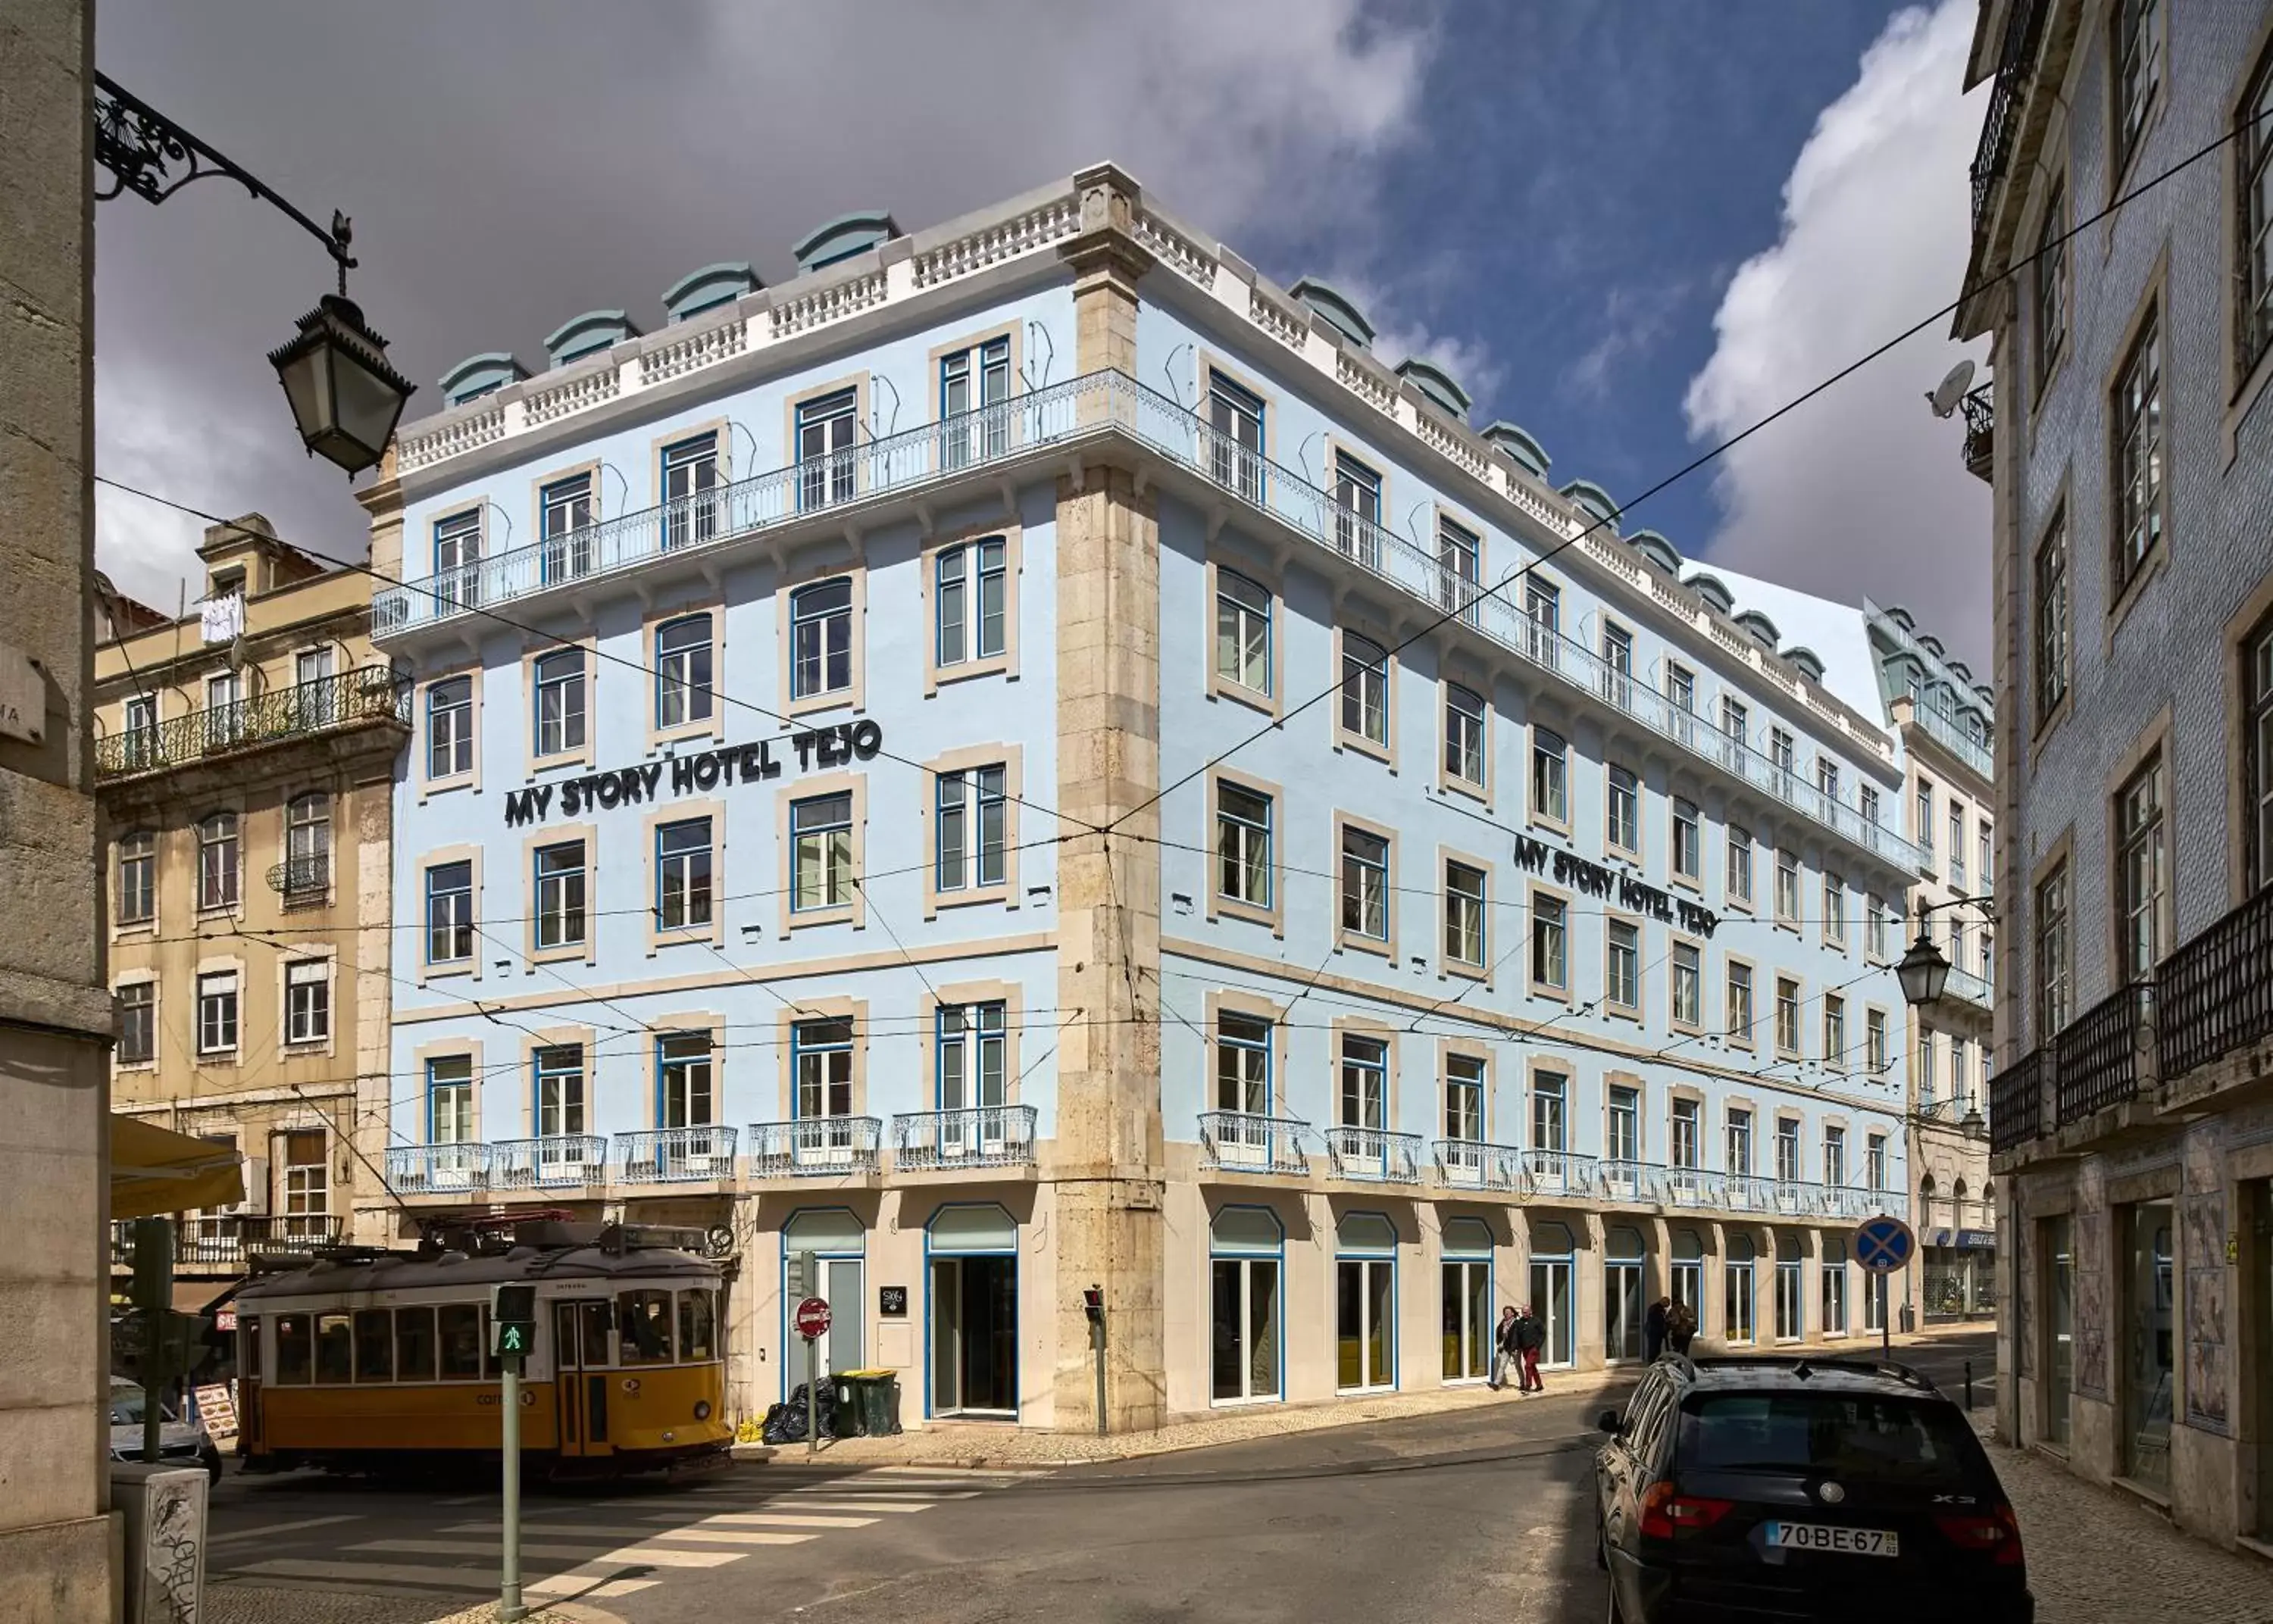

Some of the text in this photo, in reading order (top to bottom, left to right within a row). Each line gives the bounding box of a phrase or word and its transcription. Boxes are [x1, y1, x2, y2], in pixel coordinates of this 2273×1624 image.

[505, 719, 882, 827] MY STORY HOTEL TEJO
[1514, 835, 1716, 939] MY STORY HOTEL TEJO
[1931, 1494, 1977, 1504] X3
